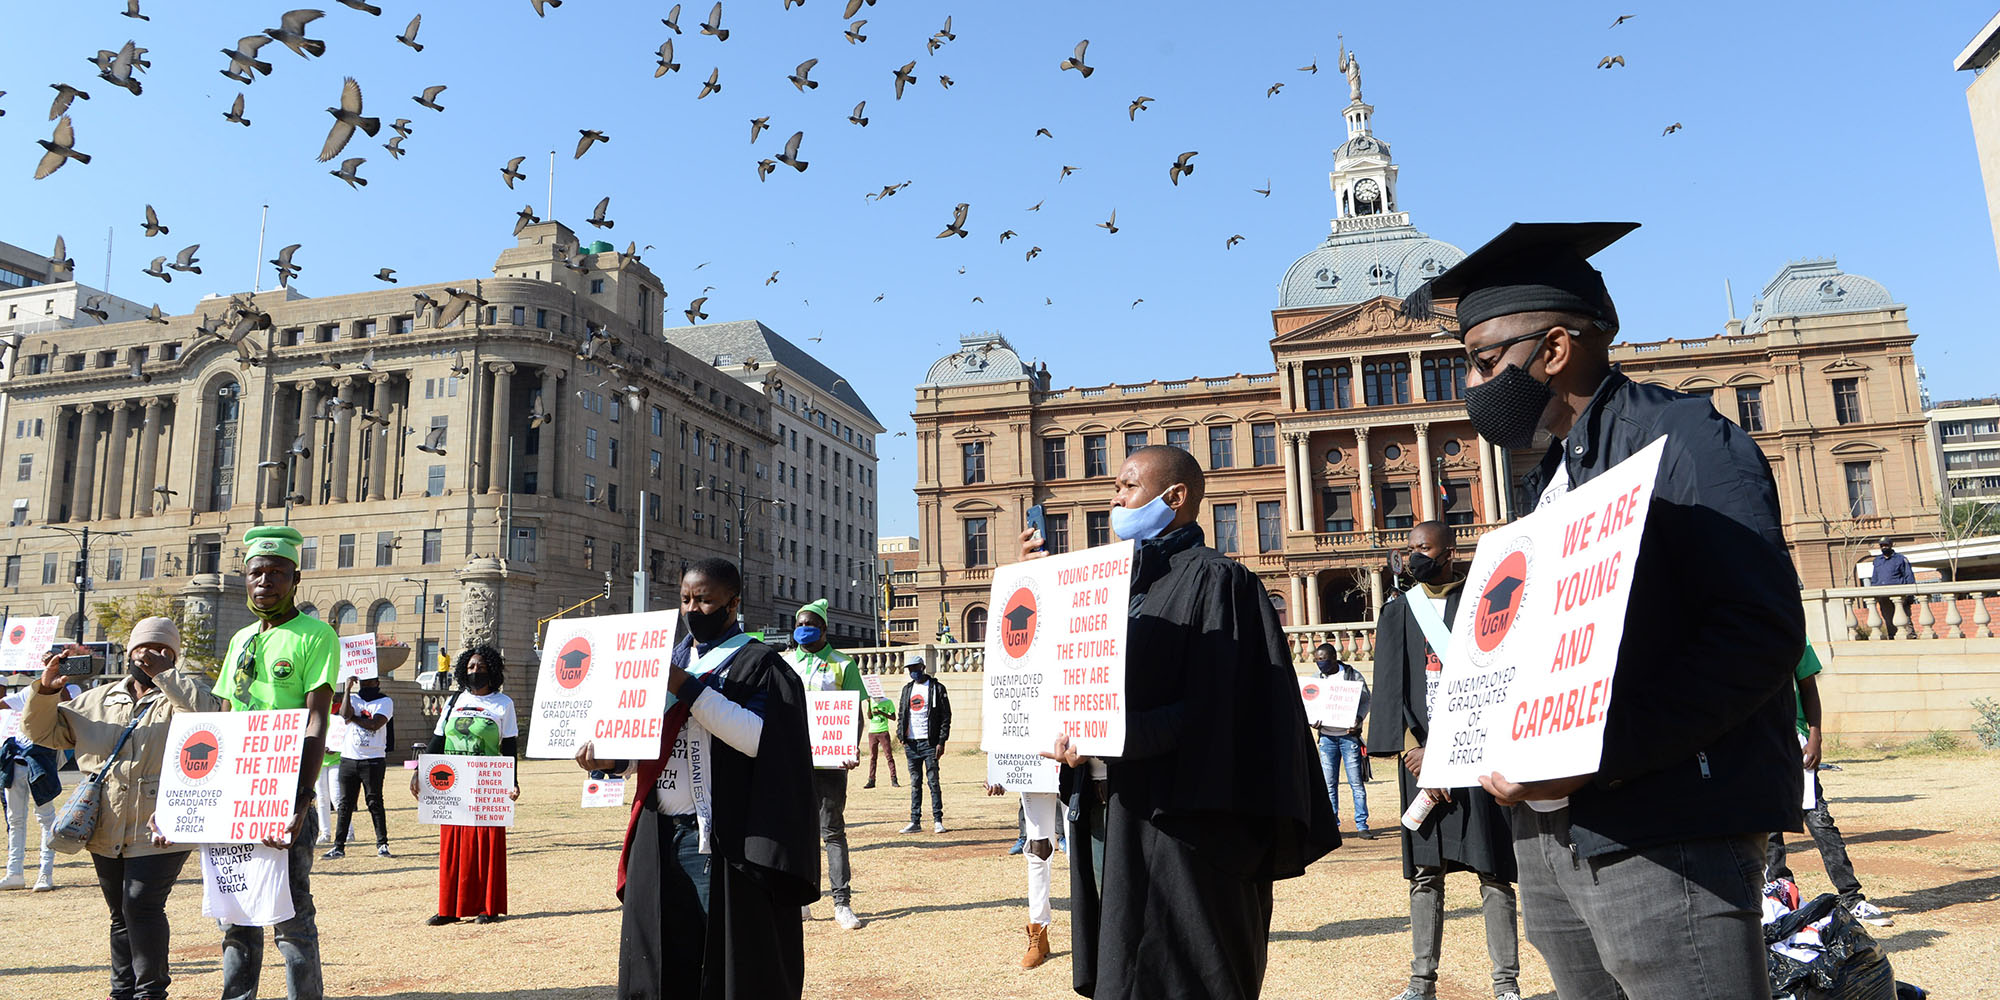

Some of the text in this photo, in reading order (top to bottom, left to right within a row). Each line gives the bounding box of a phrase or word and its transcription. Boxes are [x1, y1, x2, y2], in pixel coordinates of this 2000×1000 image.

[1562, 484, 1641, 558] WE ARE
[1057, 557, 1130, 586] YOUNG PEOPLE
[1553, 551, 1622, 615] YOUNG
[1072, 587, 1108, 609] ARE NO
[1069, 613, 1108, 634] LONGER
[1481, 612, 1509, 637] UGM
[345, 639, 374, 649] NOTHING
[617, 629, 669, 651] WE ARE
[1007, 631, 1028, 647] UGM
[1550, 622, 1595, 673] AND
[347, 650, 361, 658] FOR
[1057, 639, 1119, 660] THE FUTURE.
[346, 656, 376, 667] WITHOUT
[615, 658, 660, 680] YOUNG
[561, 670, 582, 680] UGM
[990, 673, 1043, 687] UNEMPLOYED
[1063, 666, 1109, 685] THEY ARE
[1447, 667, 1516, 696] UNEMPLOYED
[617, 689, 647, 709] AND
[993, 687, 1039, 699] GRADUATES
[1448, 687, 1507, 713] GRADUATES
[541, 700, 593, 709] UNEMPLOYED
[815, 700, 853, 711] WE ARE
[1011, 700, 1021, 711] OF
[1053, 693, 1120, 714] THE PRESENT,
[1511, 677, 1610, 742] CAPABLE!
[248, 713, 300, 732] WE ARE
[542, 710, 588, 719] GRADUATES
[816, 715, 850, 726] YOUNG
[1002, 713, 1029, 724] SOUTH
[1467, 711, 1481, 728] OF
[559, 719, 570, 728] OF
[594, 718, 661, 739] CAPABLE!
[1002, 726, 1030, 738] AFRICA
[1063, 720, 1108, 738] THE NOW
[550, 728, 576, 738] SOUTH
[822, 730, 843, 740] AND
[1452, 728, 1487, 748] SOUTH
[242, 734, 298, 753] FED UP!
[548, 738, 575, 747] AFRICA
[235, 756, 300, 774] THE TIME
[489, 761, 514, 769] PEOPLE
[691, 740, 701, 784] FABIANI
[1448, 747, 1483, 766] AFRICA
[186, 761, 208, 771] UGM
[165, 790, 223, 798] UNEMPLOYED
[251, 778, 278, 796] FOR
[693, 786, 705, 804] EST
[168, 798, 217, 807] GRADUATES
[233, 799, 290, 818] TALKING
[176, 816, 205, 824] SOUTH
[186, 807, 197, 816] OF
[174, 824, 204, 833] AFRICA
[230, 821, 286, 840] IS OVER
[216, 873, 246, 885] SOUTH
[222, 866, 233, 875] OF
